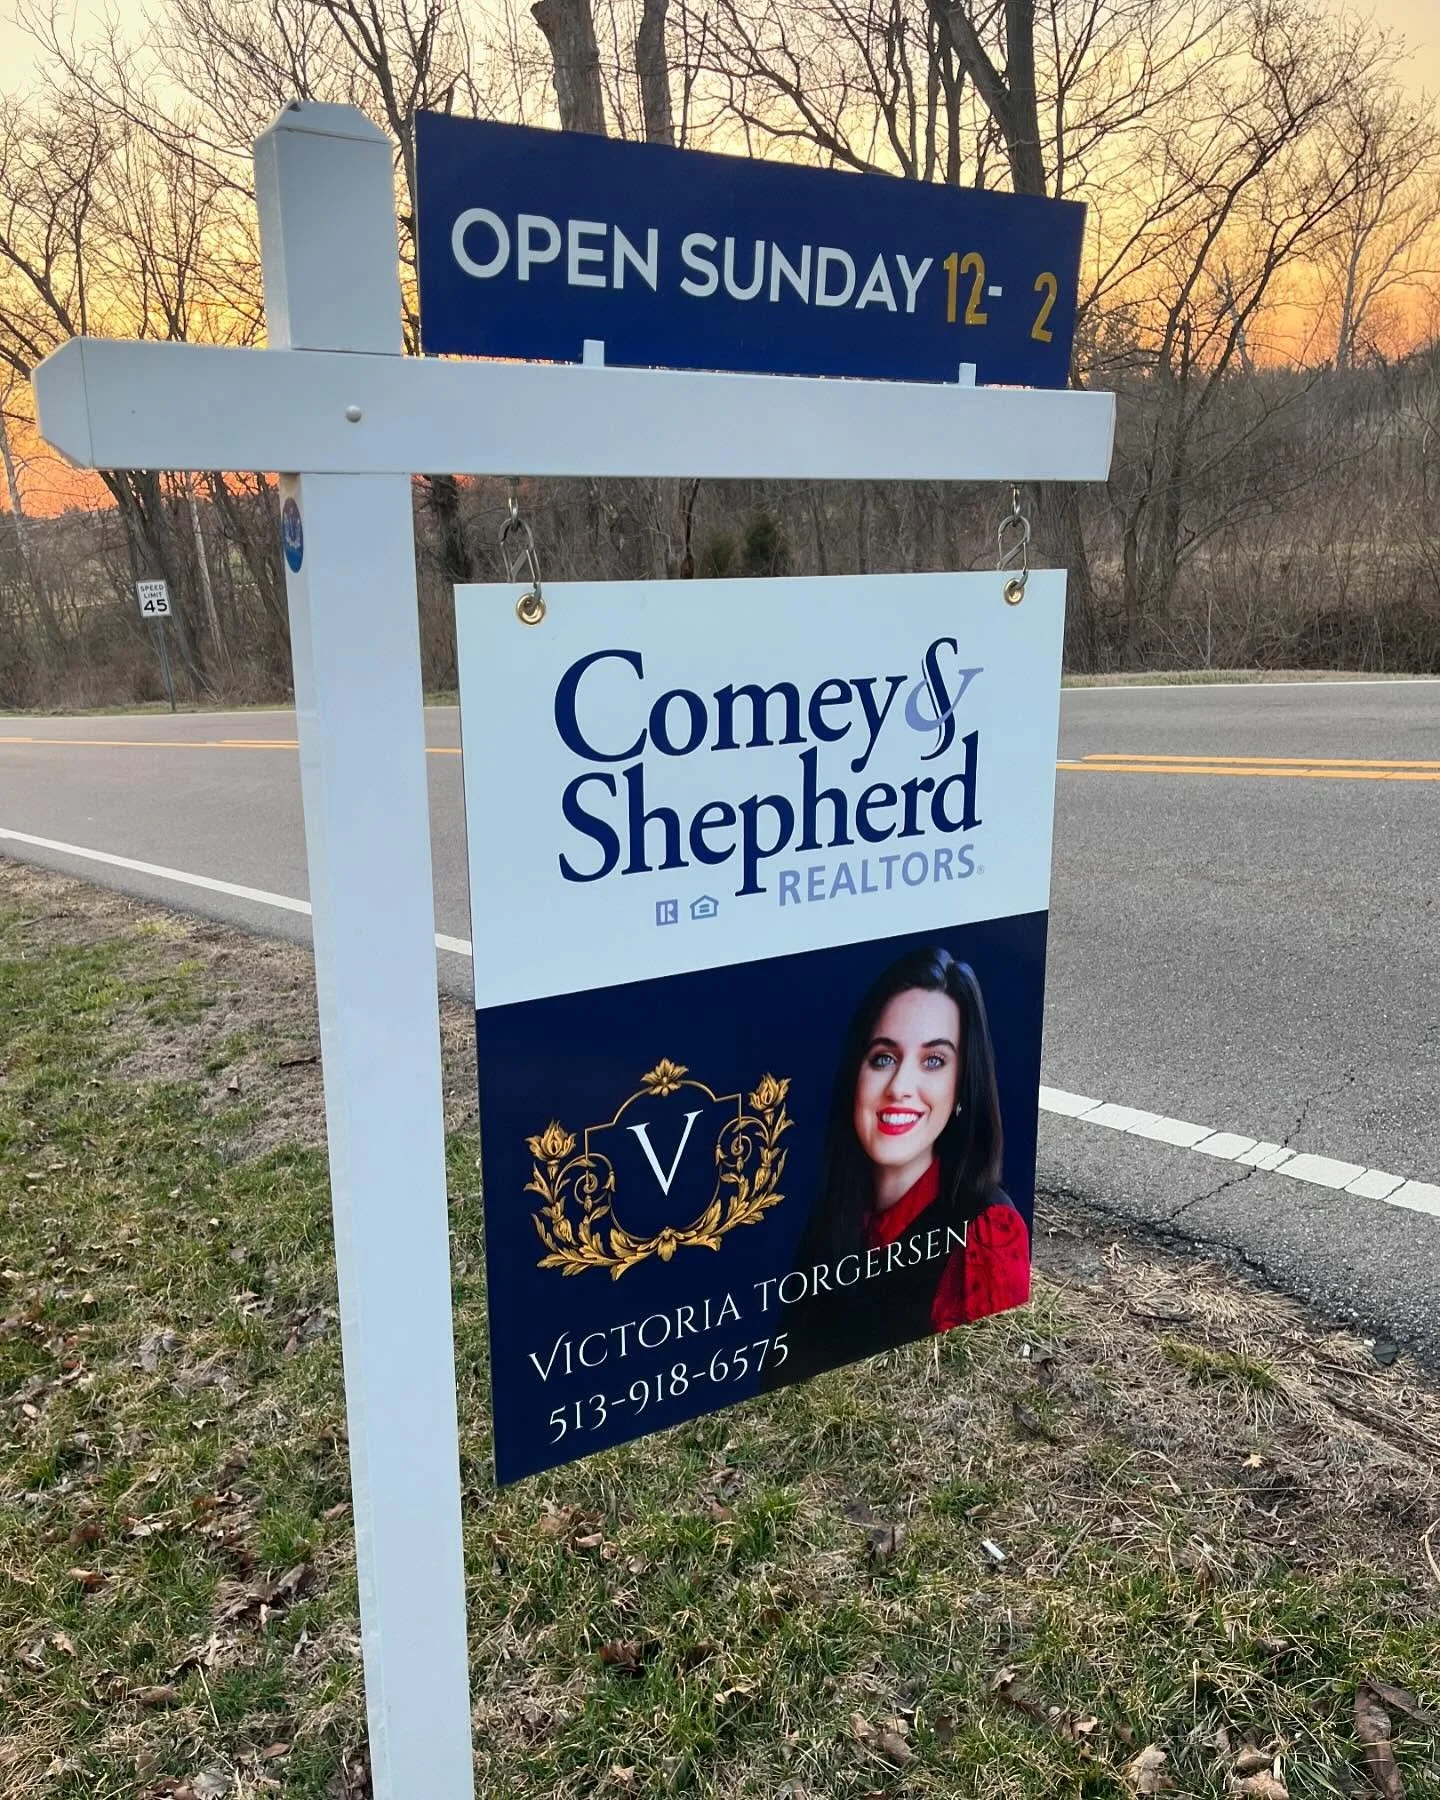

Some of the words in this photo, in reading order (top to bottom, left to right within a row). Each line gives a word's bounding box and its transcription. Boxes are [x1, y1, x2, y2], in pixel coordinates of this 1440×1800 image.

[451, 207, 659, 291] OPEN
[680, 232, 933, 313] SUNDAY
[1031, 272, 1057, 343] 2
[143, 591, 162, 599] LIMIT
[143, 598, 168, 613] 45
[558, 730, 982, 896] Shepherd
[626, 1109, 704, 1197] V
[527, 1292, 743, 1384] VICTORIA
[753, 1219, 970, 1313] TORGERSEN
[549, 1333, 791, 1446] 513-918-6575
